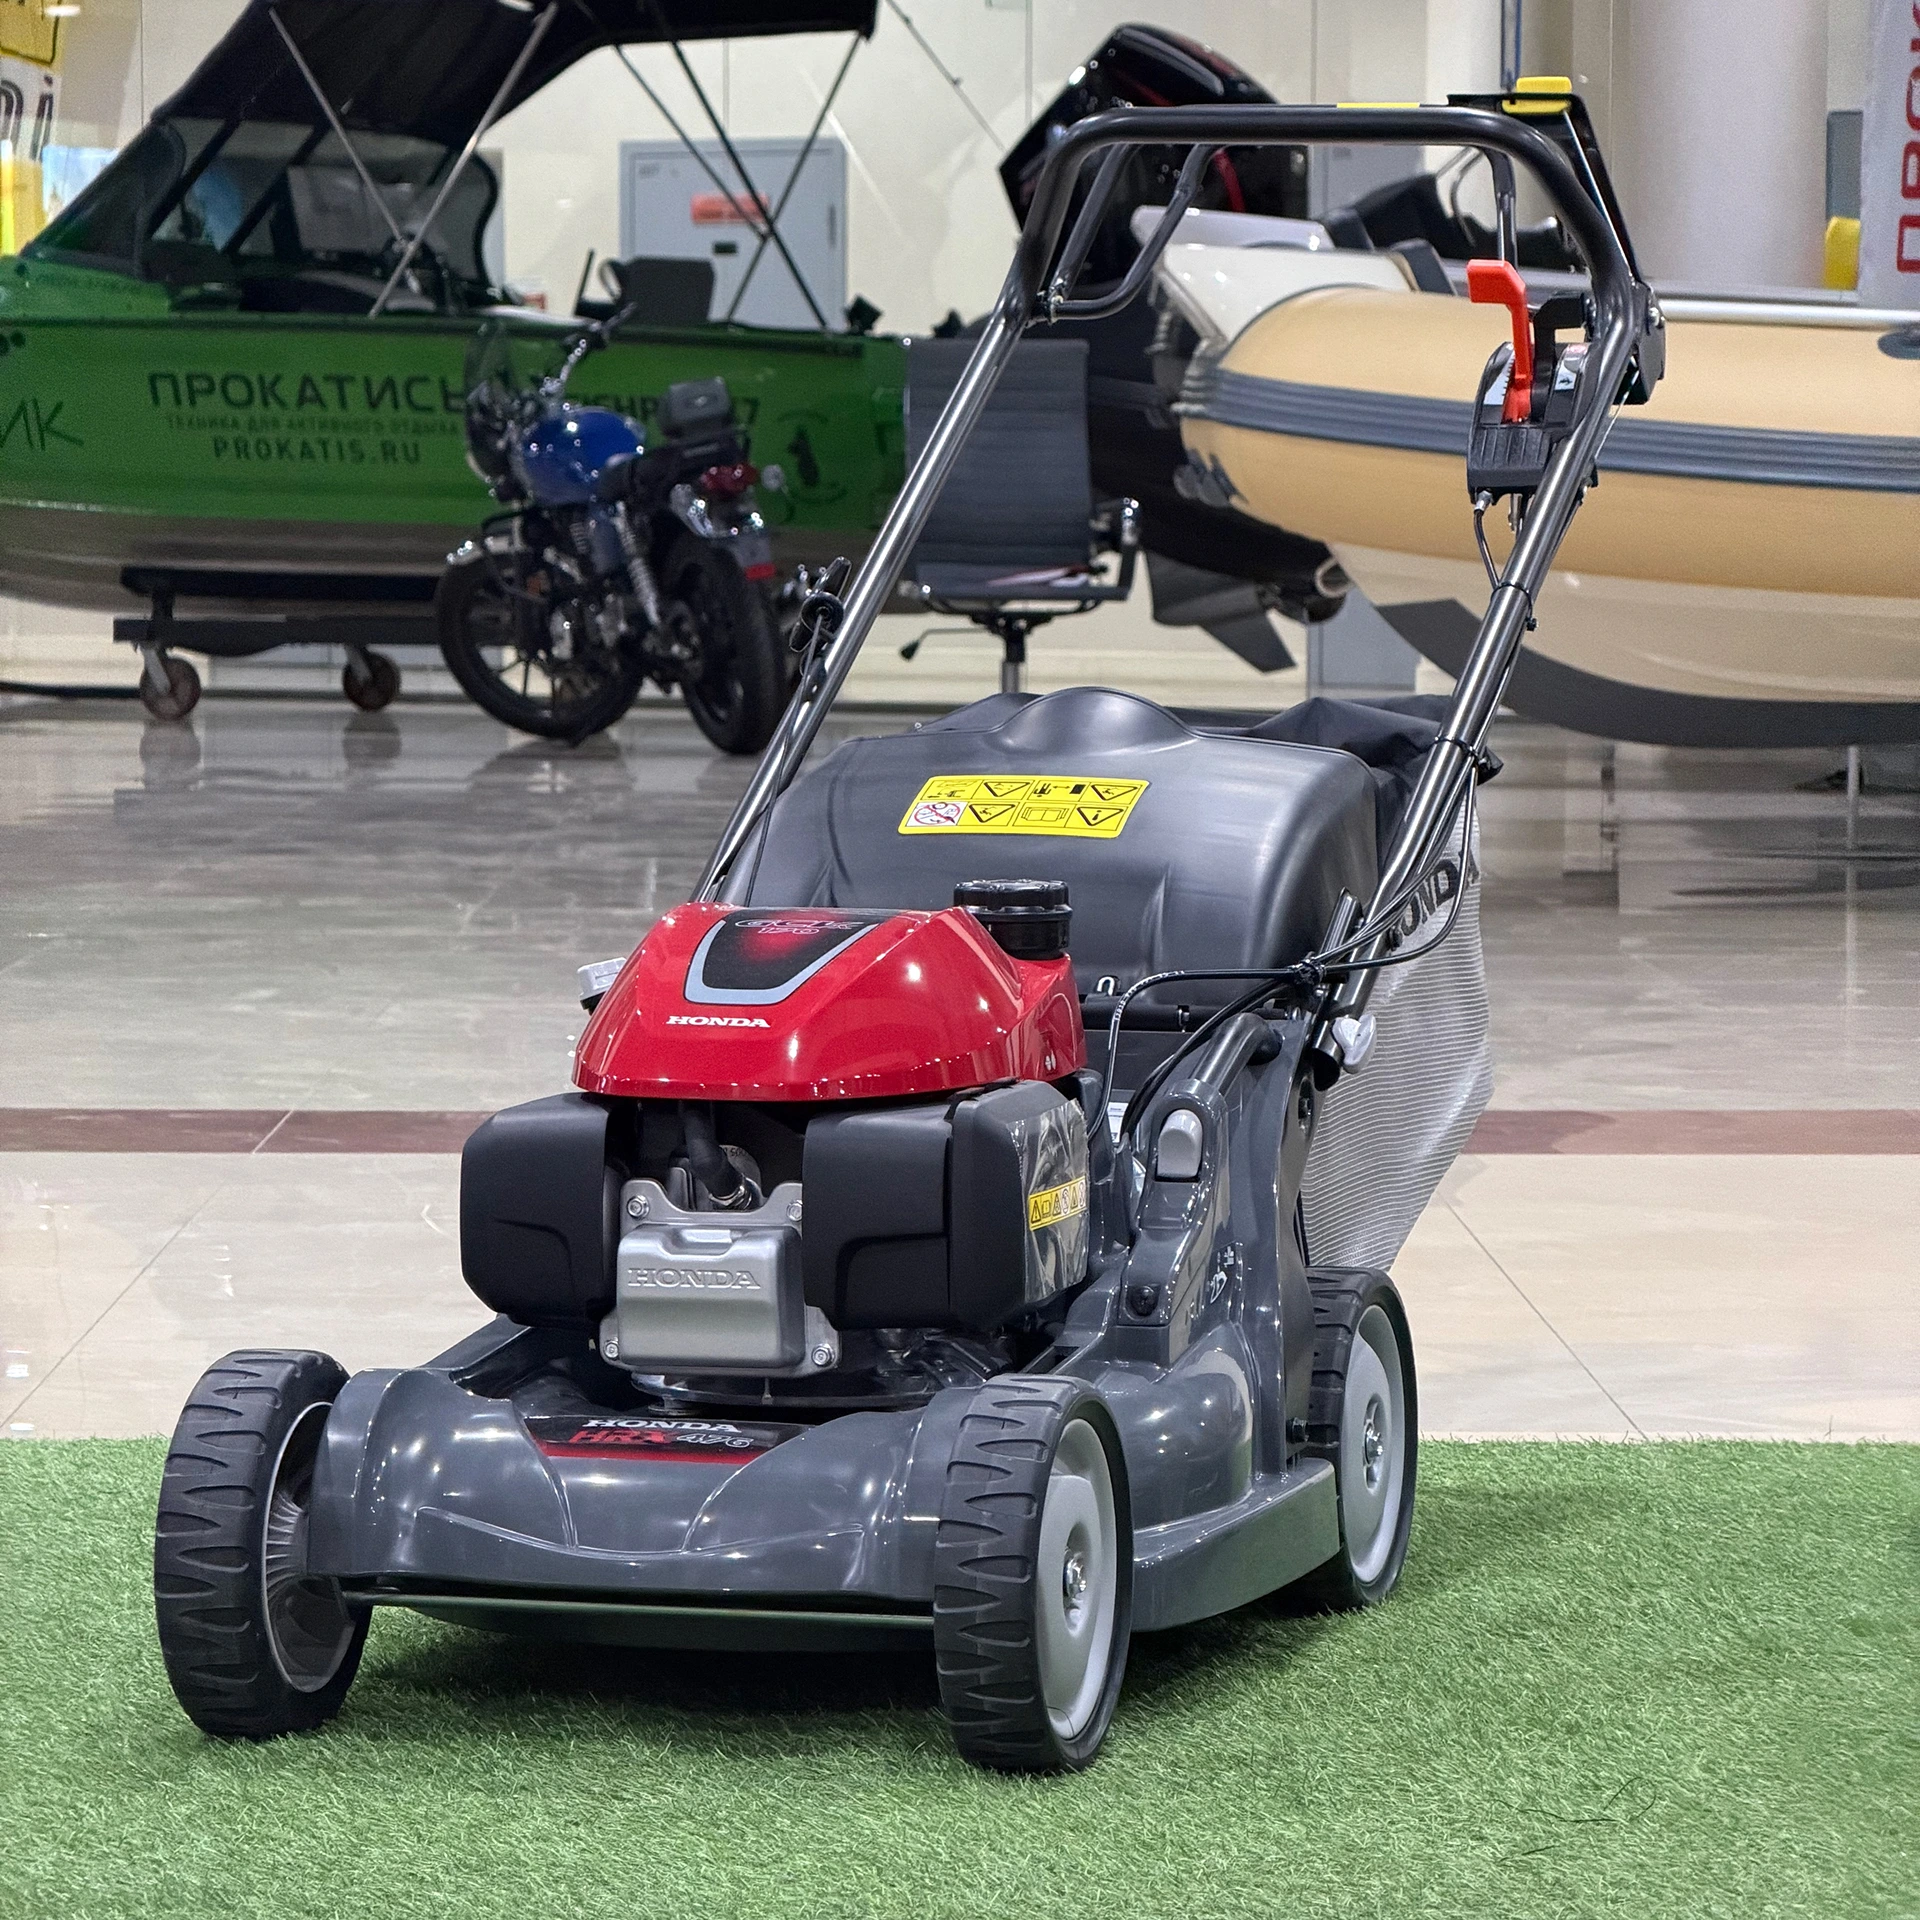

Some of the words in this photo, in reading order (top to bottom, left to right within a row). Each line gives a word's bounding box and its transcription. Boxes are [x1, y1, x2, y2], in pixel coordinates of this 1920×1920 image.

[148, 371, 467, 414] ПРОКАТИСЬ
[212, 435, 422, 465] PROKATIS.RU
[665, 1015, 771, 1029] HONDA
[627, 1267, 761, 1290] HONDA
[582, 1419, 742, 1433] HONDA
